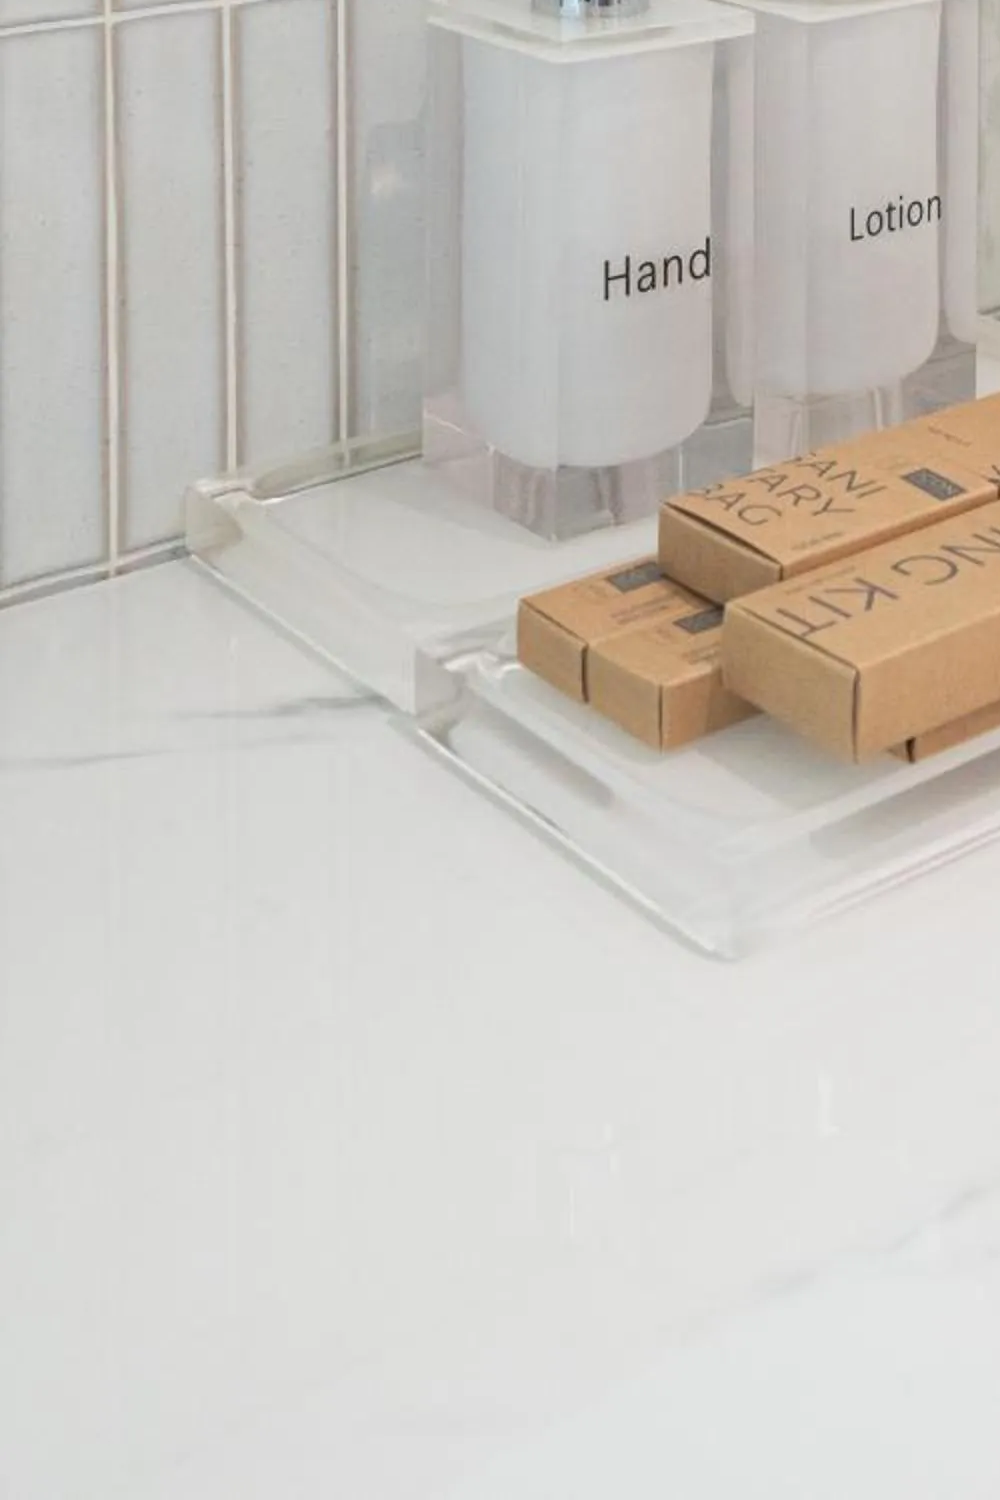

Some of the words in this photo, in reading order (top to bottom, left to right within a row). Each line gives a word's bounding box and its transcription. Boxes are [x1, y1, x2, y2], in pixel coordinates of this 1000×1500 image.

[849, 195, 943, 242] Lotion
[602, 236, 713, 302] Hand
[774, 575, 900, 638] KIT
